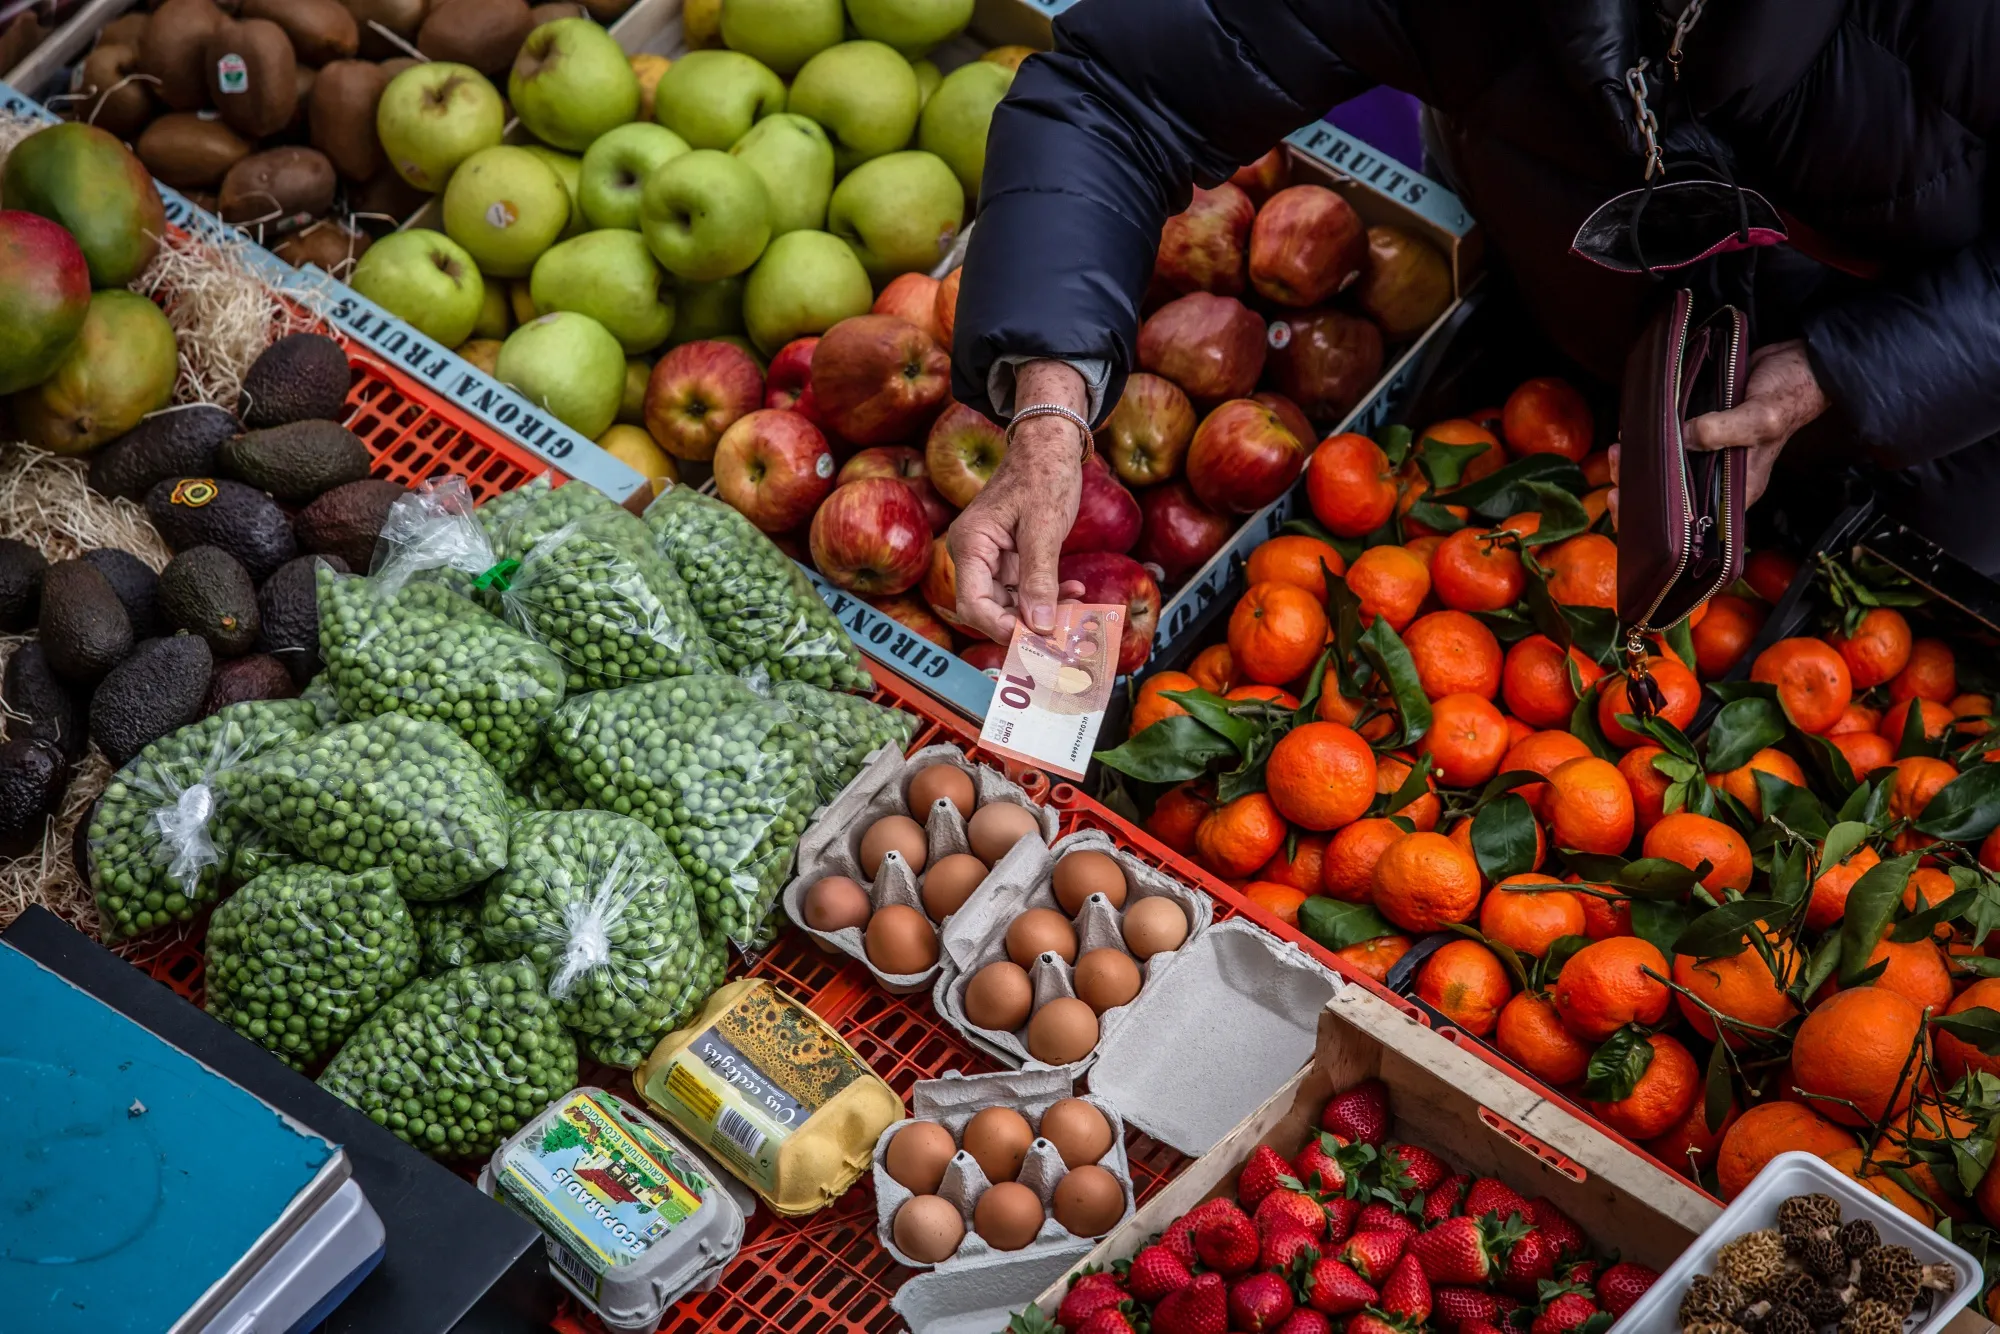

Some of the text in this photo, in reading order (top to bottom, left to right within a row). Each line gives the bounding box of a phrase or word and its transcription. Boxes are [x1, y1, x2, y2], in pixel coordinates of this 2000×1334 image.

[1305, 129, 1428, 204] FRUITS
[332, 297, 574, 460] GIRONA FRUITS
[831, 593, 950, 678] GIRONA
[1000, 673, 1036, 710] 10
[1001, 721, 1014, 744] EURO
[765, 1095, 796, 1125] Ous
[620, 1140, 670, 1185] AGRICULTURA
[551, 1167, 648, 1255] ECOPARADIS
